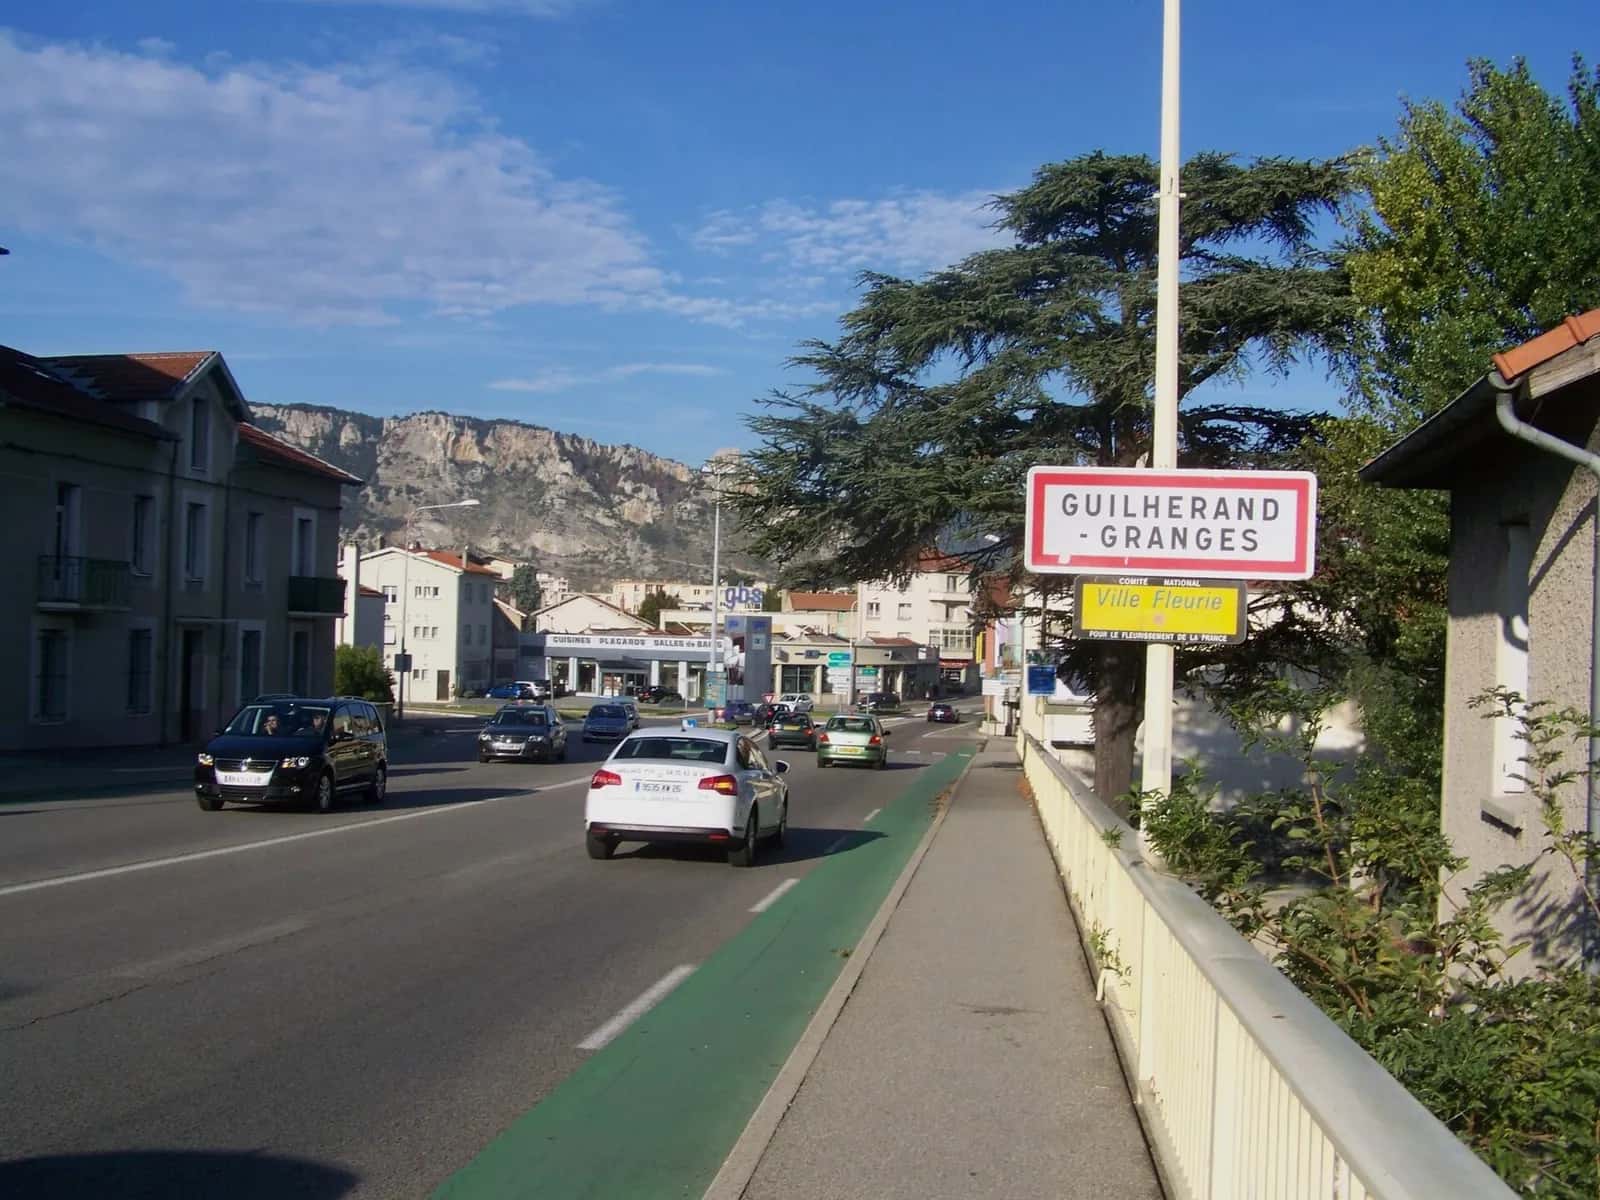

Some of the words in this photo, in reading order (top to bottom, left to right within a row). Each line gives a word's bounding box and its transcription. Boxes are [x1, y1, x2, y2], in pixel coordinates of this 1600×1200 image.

[1061, 493, 1279, 521] GUILHERAND
[1163, 579, 1200, 587] NATIONAL
[1097, 588, 1140, 608] Ville
[1151, 589, 1223, 611] Fleurie
[552, 636, 592, 645] CUISINES
[599, 637, 646, 646] PLACARDS
[653, 639, 685, 648] SALLES
[696, 640, 723, 649] BAIS
[1110, 631, 1119, 639] LE
[1121, 632, 1174, 640] FLEURISSEMENT
[1177, 633, 1187, 641] DE
[1189, 634, 1199, 642] LA
[1201, 634, 1228, 643] FRANCE
